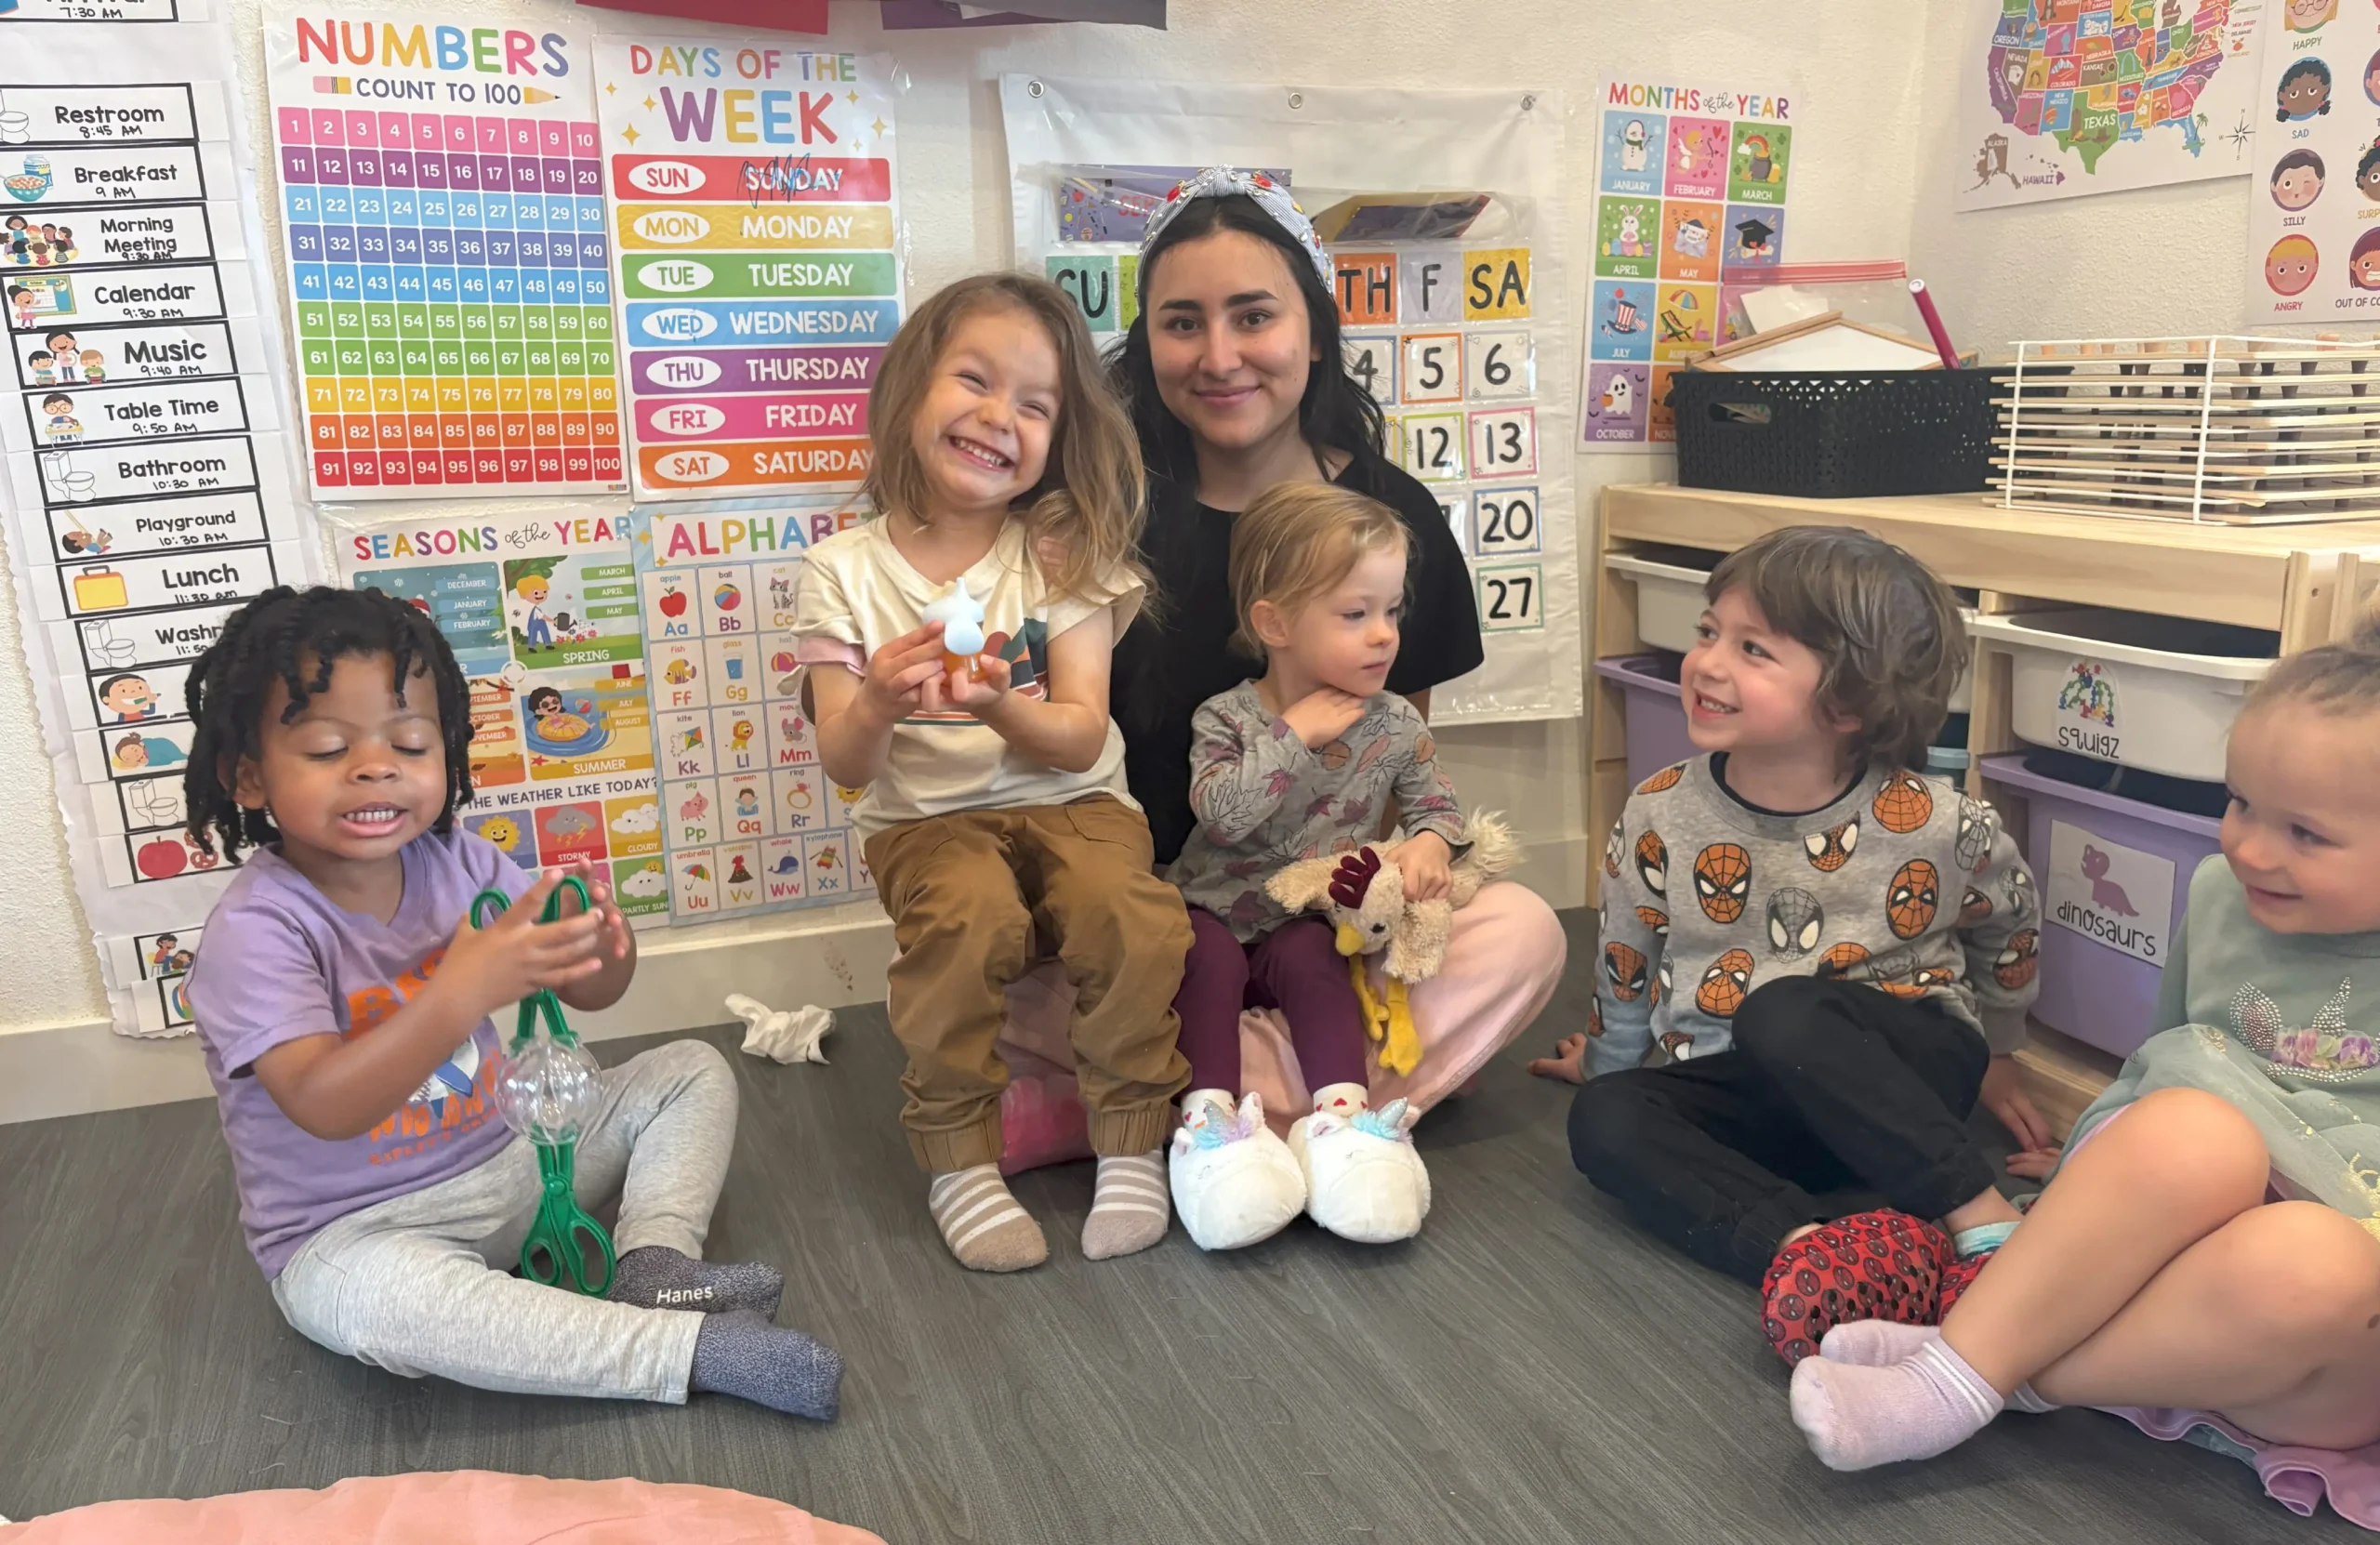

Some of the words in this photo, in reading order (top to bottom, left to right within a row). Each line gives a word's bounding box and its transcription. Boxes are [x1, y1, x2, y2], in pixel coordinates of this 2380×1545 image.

[60, 7, 96, 18] 7:30
[102, 7, 123, 19] AM
[297, 18, 569, 77] NUMBERS
[1993, 35, 2019, 46] OREGON
[2293, 36, 2322, 50] HAPPY
[630, 45, 721, 77] DAYS
[736, 49, 781, 79] OF
[796, 51, 856, 82] THE
[356, 78, 435, 101] COUNT
[445, 82, 475, 102] TO
[485, 84, 521, 104] 100
[1608, 82, 1700, 112] MONTHS
[1702, 94, 1720, 113] of
[1715, 92, 1734, 109] the
[1737, 94, 1790, 119] YEAR
[55, 105, 165, 125] Restroom
[659, 86, 838, 144] WEEK
[2083, 113, 2117, 129] TEXAS
[80, 125, 112, 139] 8:45
[122, 125, 142, 137] AM
[2292, 128, 2309, 139] SAD
[74, 165, 177, 184] Breakfast
[292, 159, 305, 171] 11
[324, 160, 341, 173] 12
[357, 162, 374, 174] 13
[390, 163, 406, 175] 14
[423, 165, 440, 177] 15
[455, 166, 471, 178] 16
[487, 167, 502, 179] 17
[519, 169, 535, 180] 18
[549, 170, 565, 182] 19
[579, 171, 597, 183] 20
[646, 167, 689, 188] SUN
[745, 167, 844, 191] SUNDAY
[1612, 179, 1651, 191] JANUARY
[2022, 175, 2055, 185] HAWAII
[95, 187, 106, 199] 9
[113, 187, 136, 199] AM
[1673, 185, 1716, 197] FEBRUARY
[1741, 190, 1772, 201] MARCH
[100, 218, 174, 233] Morning
[645, 217, 698, 237] MON
[742, 216, 853, 239] MONDAY
[2283, 216, 2306, 226] SILLY
[104, 238, 177, 254] Meeting
[121, 252, 149, 261] 9:30
[152, 252, 173, 260] AM
[657, 266, 694, 285] TUE
[748, 263, 853, 287] TUESDAY
[1613, 265, 1639, 275] APRIL
[1679, 269, 1699, 278] MAY
[1337, 266, 1392, 313] TH
[1422, 263, 1441, 312] F
[1469, 259, 1526, 310] SA
[95, 284, 195, 304] Calendar
[2274, 301, 2303, 311] ANGRY
[2335, 298, 2352, 308] OUT
[2355, 297, 2368, 307] OF
[123, 308, 156, 319] 9:30
[161, 309, 184, 318] AM
[656, 315, 703, 334] WED
[729, 310, 879, 335] WEDNESDAY
[124, 340, 207, 363] Music
[1611, 349, 1631, 359] JULY
[140, 365, 172, 376] 9:40
[178, 364, 202, 375] AM
[746, 357, 869, 382] THURSDAY
[1353, 349, 1379, 391] 4
[1420, 346, 1444, 390] 5
[1484, 343, 1511, 385] 6
[665, 363, 704, 382] THU
[315, 389, 331, 401] 71
[346, 389, 364, 401] 72
[379, 389, 397, 401] 73
[411, 389, 429, 401] 74
[443, 389, 460, 400] 75
[474, 389, 492, 400] 76
[505, 389, 522, 400] 77
[535, 389, 552, 400] 78
[565, 389, 582, 400] 79
[594, 389, 612, 400] 80
[104, 403, 162, 421] Table
[168, 400, 218, 416] Time
[765, 403, 857, 429] FRIDAY
[669, 410, 707, 429] FRI
[132, 423, 168, 435] 9:50
[174, 423, 198, 433] AM
[1596, 429, 1634, 440] OCTOBER
[1416, 426, 1452, 470] 12
[1487, 421, 1523, 465] 13
[118, 457, 226, 479] Bathroom
[673, 457, 710, 476] SAT
[754, 450, 872, 475] SATURDAY
[152, 479, 189, 491] 10:30
[198, 477, 219, 487] AM
[136, 510, 236, 533] Playground
[1481, 499, 1534, 543] 20
[159, 534, 199, 547] 10:30
[205, 533, 229, 542] AM
[352, 526, 498, 561] SEASONS
[505, 530, 526, 548] of
[522, 522, 550, 542] the
[162, 563, 240, 588] Lunch
[659, 574, 681, 583] apple
[447, 580, 486, 589] DECEMBER
[454, 600, 487, 609] JANUARY
[1488, 576, 1533, 619] 27
[454, 619, 491, 628] FEBRUARY
[719, 616, 741, 631] Bb
[774, 613, 794, 627] Cc
[664, 621, 689, 637] Aa
[562, 649, 610, 664] SPRING
[670, 645, 685, 654] fish
[672, 691, 692, 706] Ff
[726, 685, 747, 701] Gg
[2057, 726, 2120, 759] squigz
[736, 754, 750, 769] Ll
[780, 748, 812, 763] Mm
[573, 759, 626, 774] SUMMER
[678, 760, 701, 775] Kk
[789, 769, 805, 777] ring
[497, 788, 563, 806] WEATHER
[568, 784, 601, 797] LIKE
[737, 820, 761, 834] Qq
[791, 814, 811, 828] Rr
[685, 826, 707, 842] Pp
[628, 842, 658, 852] CLOUDY
[770, 882, 800, 898] Ww
[817, 877, 839, 891] Xx
[688, 895, 709, 910] Uu
[730, 889, 754, 903] Vv
[2056, 900, 2156, 956] dinosaurs
[656, 1286, 713, 1304] Hanes
